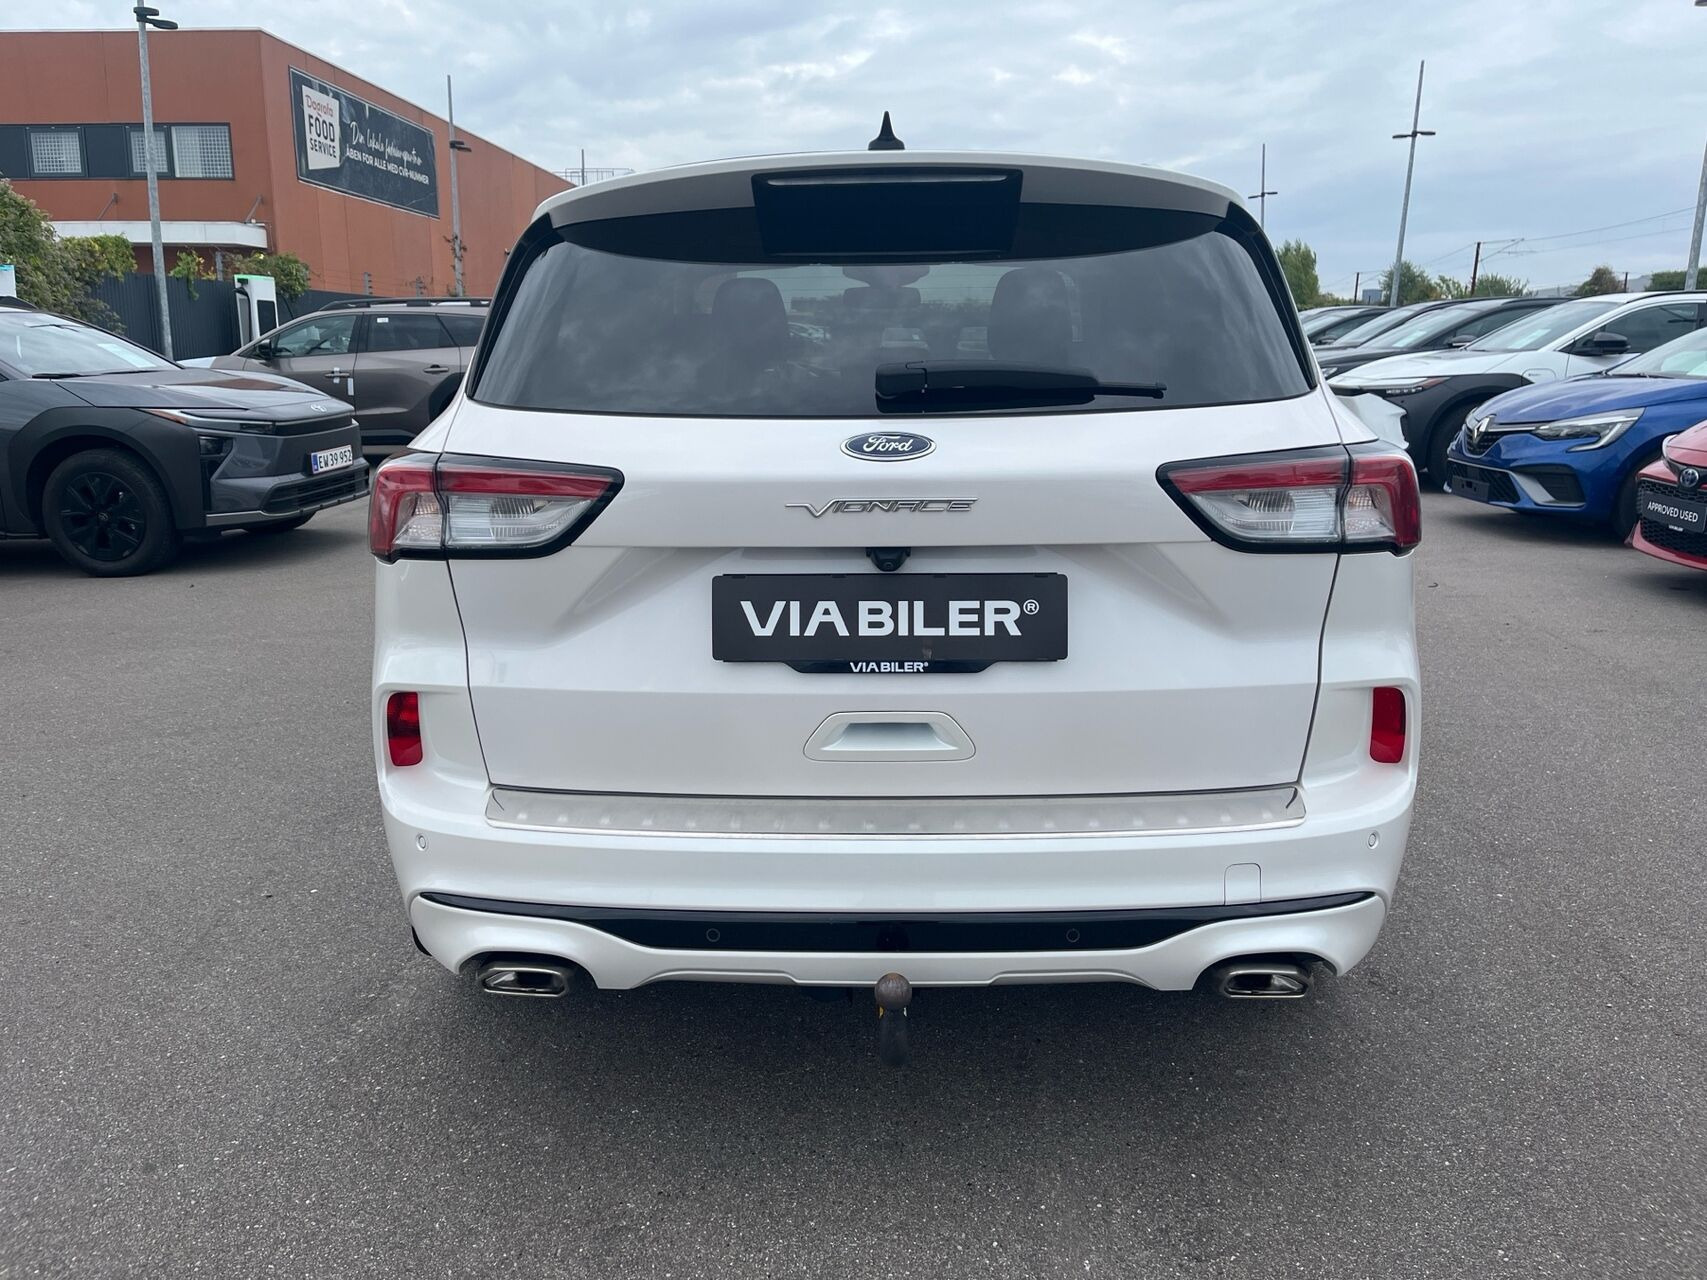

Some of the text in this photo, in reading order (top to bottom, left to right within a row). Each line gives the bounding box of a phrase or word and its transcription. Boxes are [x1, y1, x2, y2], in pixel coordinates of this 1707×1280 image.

[308, 114, 335, 142] FOOD
[309, 137, 337, 159] SERVICE
[346, 143, 430, 185] ÅBEN FOR ALLE MED CVR-NUMMER
[863, 434, 914, 452] Ford
[318, 449, 352, 469] EW 39 952
[784, 497, 979, 518] VIGNALE
[1647, 501, 1699, 522] APPROVED USED
[740, 600, 850, 636] VIA
[849, 661, 880, 673] VIA
